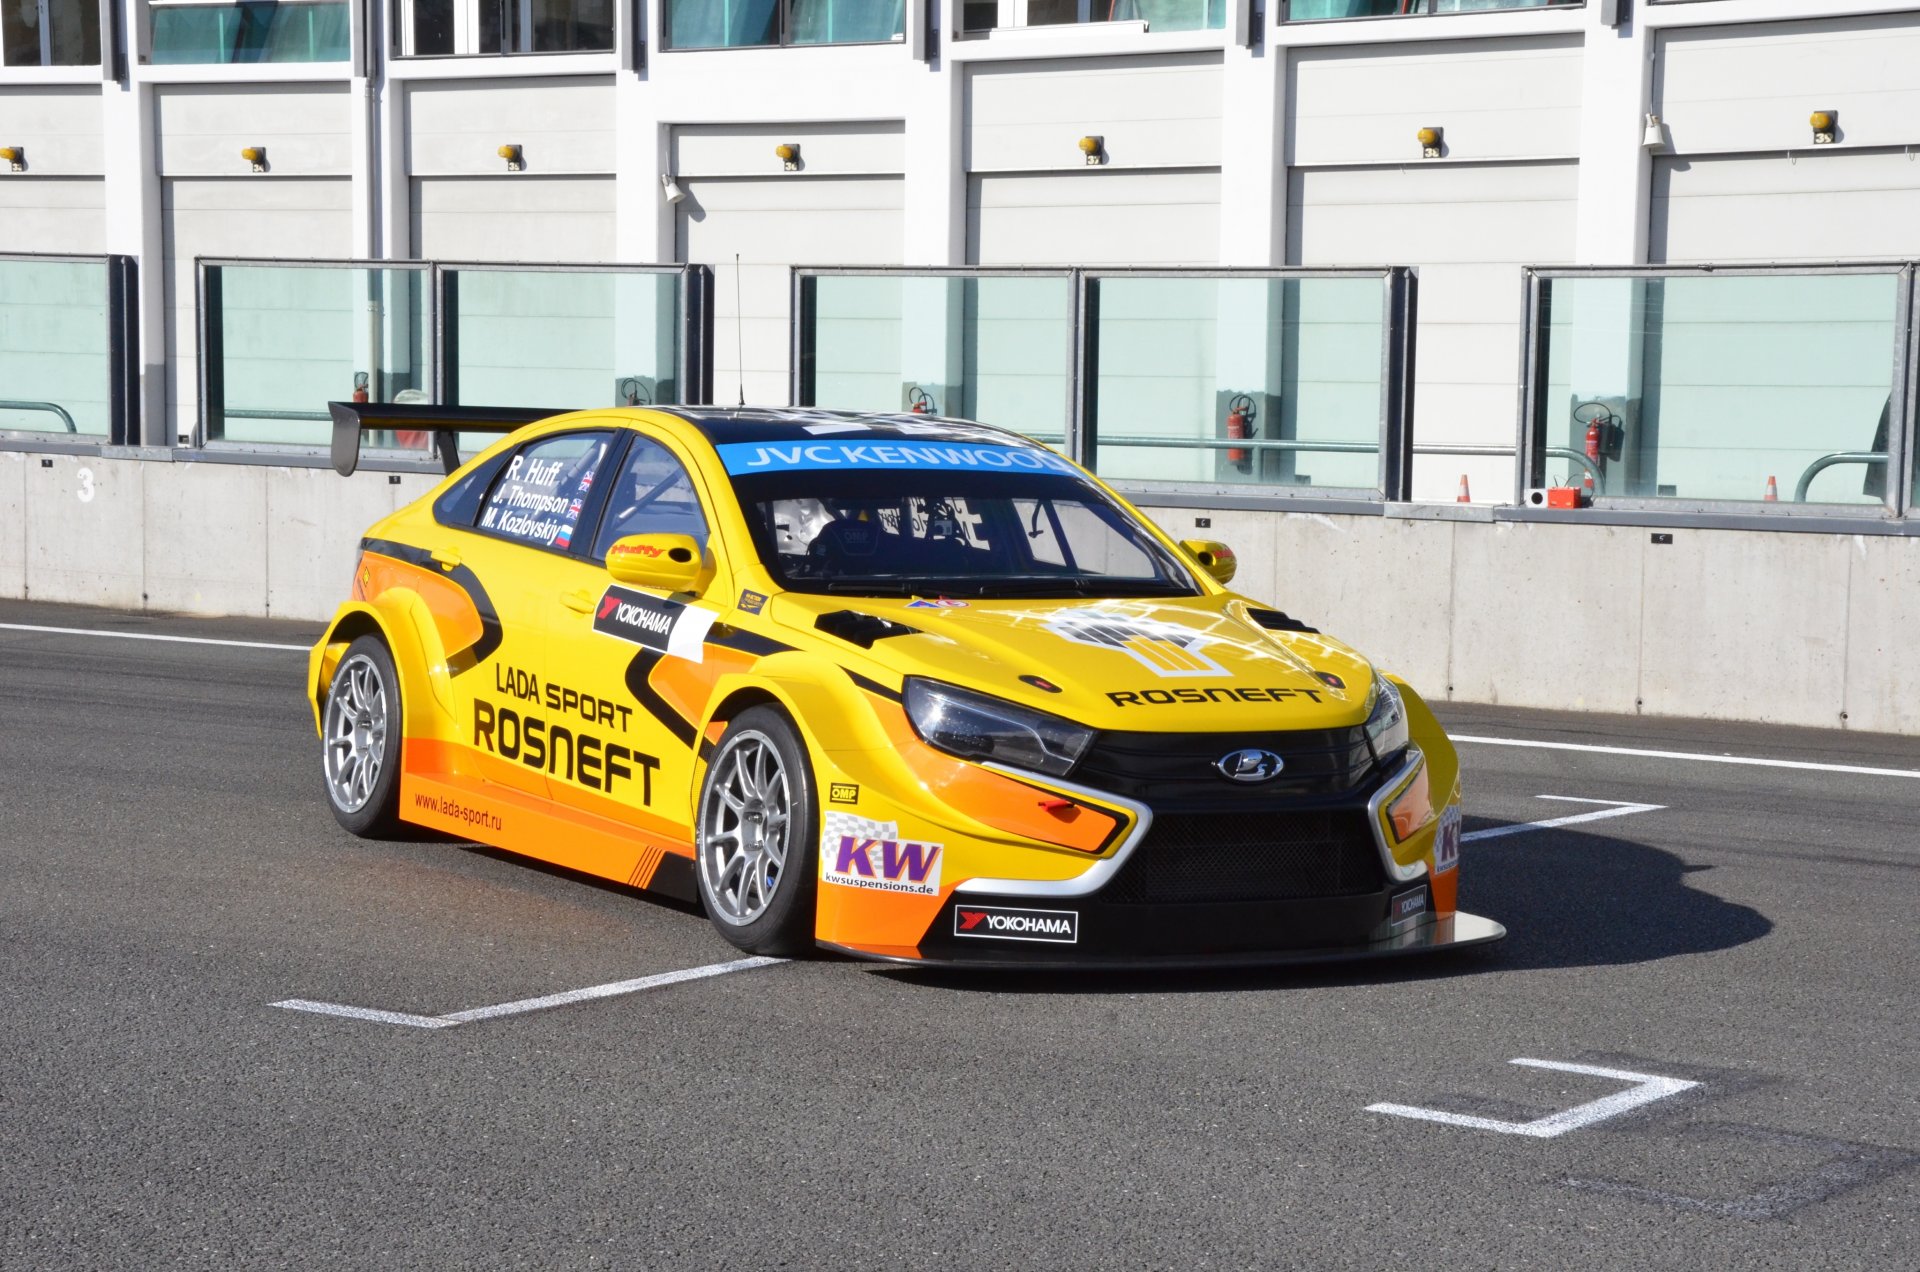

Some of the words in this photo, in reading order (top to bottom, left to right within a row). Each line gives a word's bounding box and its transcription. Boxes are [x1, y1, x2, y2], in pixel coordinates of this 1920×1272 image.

[1087, 155, 1100, 165] 37
[77, 467, 94, 502] 3
[505, 455, 523, 481] R.
[524, 458, 564, 486] Huff
[492, 485, 504, 505] J.
[507, 485, 569, 515] Thompson
[481, 507, 497, 530] M.
[500, 510, 561, 546] Kozlovskiy
[615, 602, 673, 635] YOKOHAMA
[496, 662, 540, 704] LADA
[546, 682, 633, 732] SPORT
[1104, 687, 1324, 707] ROSNEFT
[474, 697, 660, 807] ROSNEFT
[832, 787, 856, 799] OMP
[414, 792, 502, 831] www.lada-sport.ru
[835, 835, 944, 883] KW
[825, 872, 934, 895] kwsuspensions.de
[986, 915, 1072, 934] YOKOHAMA
